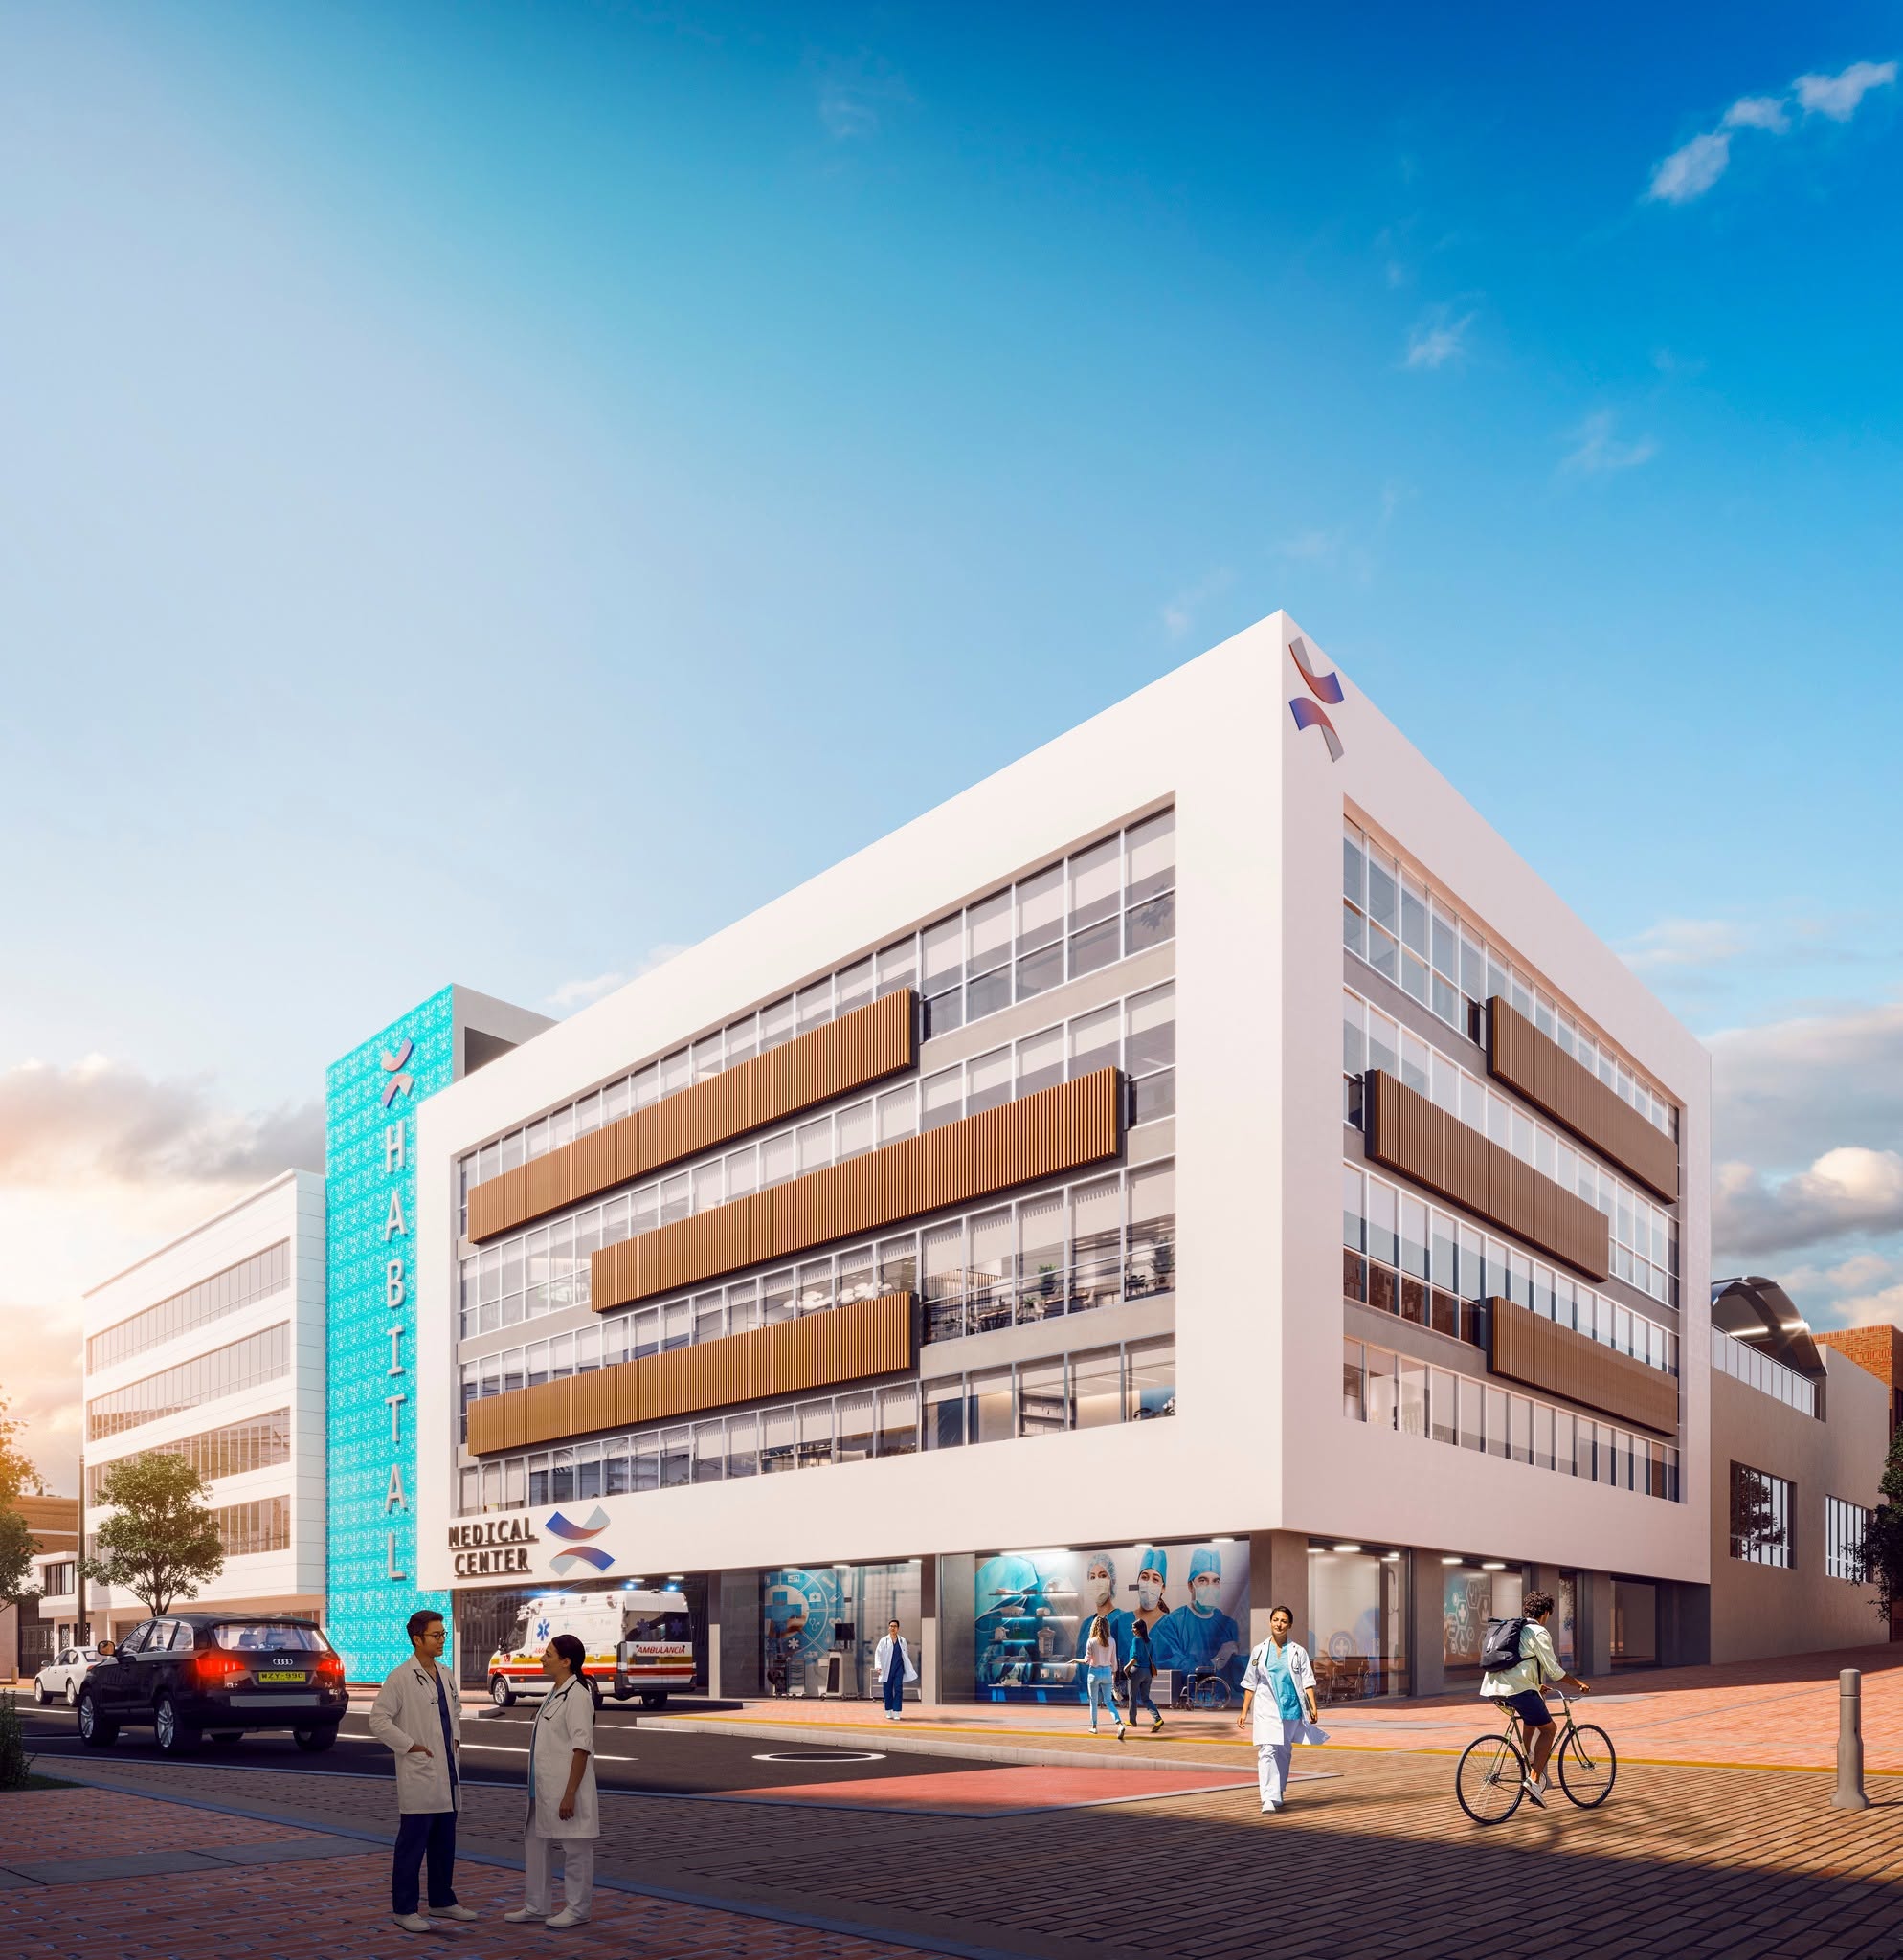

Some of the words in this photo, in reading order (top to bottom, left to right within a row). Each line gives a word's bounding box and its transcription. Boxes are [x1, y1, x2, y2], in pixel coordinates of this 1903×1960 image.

[384, 1118, 409, 1580] HABITAL
[448, 1516, 536, 1548] MEDICAL
[455, 1547, 529, 1576] CENTER
[637, 1645, 685, 1655] AMBULANCIA
